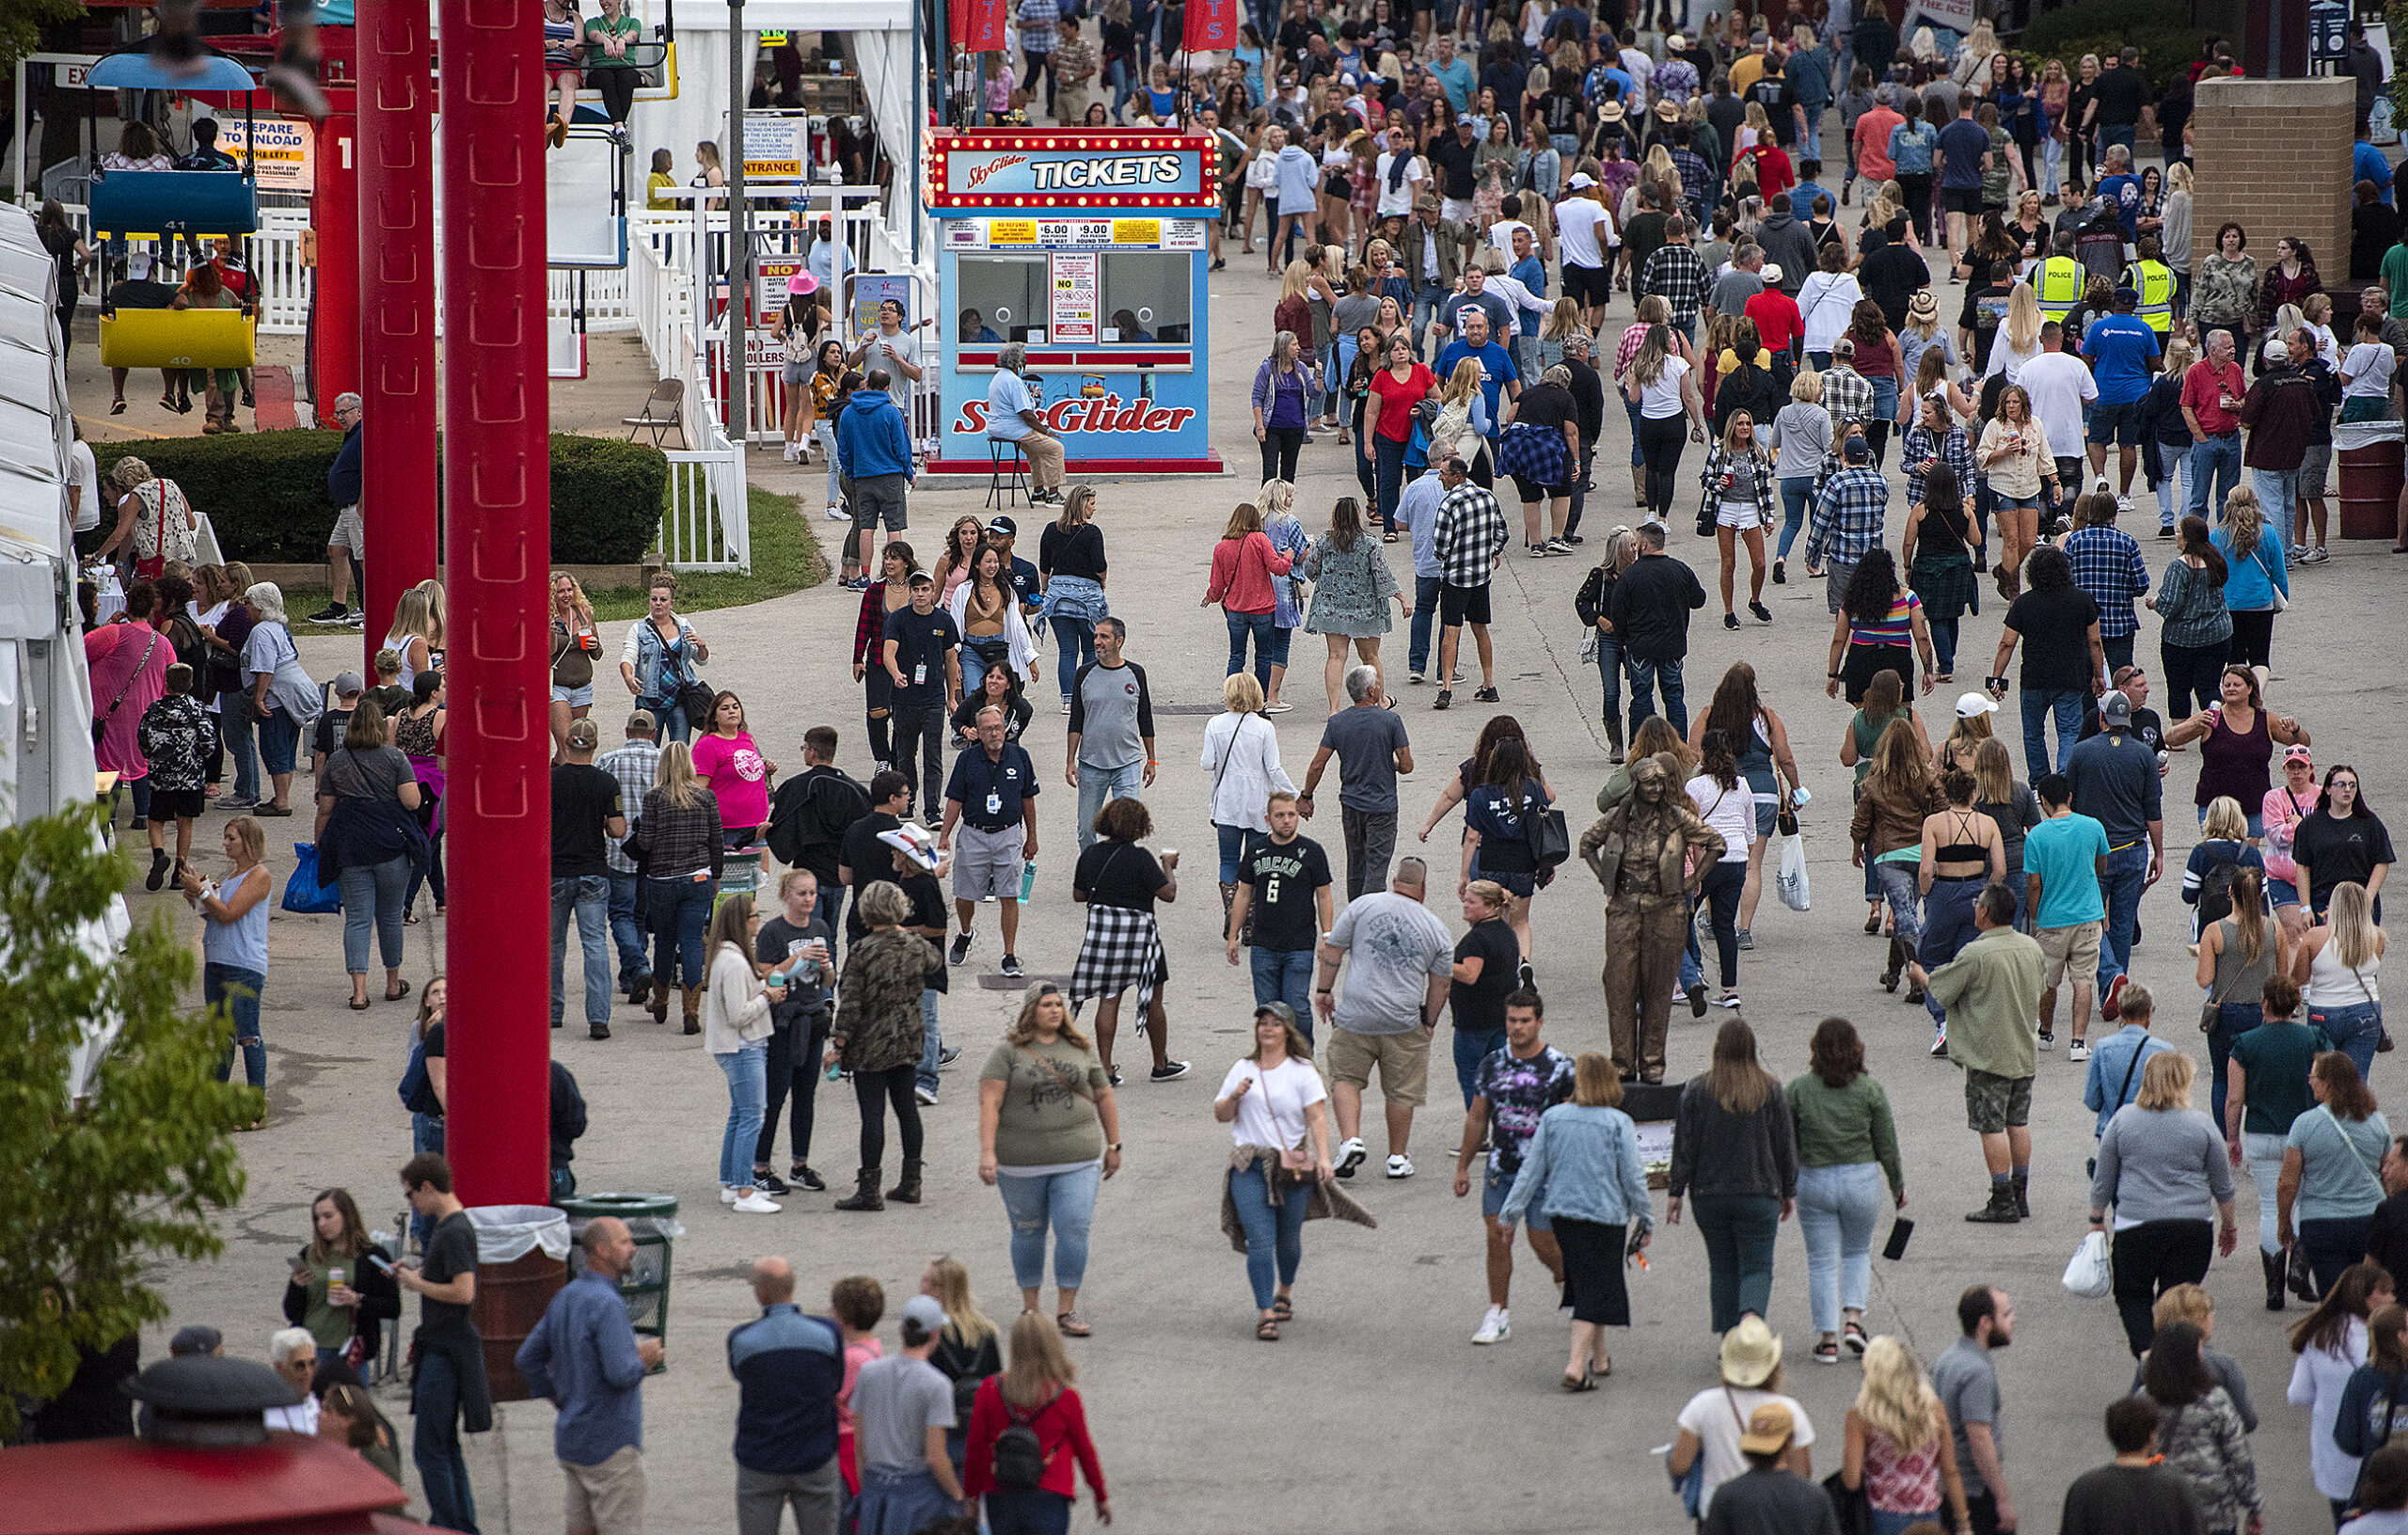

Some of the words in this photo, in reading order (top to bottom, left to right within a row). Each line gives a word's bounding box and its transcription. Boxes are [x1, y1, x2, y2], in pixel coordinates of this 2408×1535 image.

[68, 67, 88, 85] EX
[224, 132, 242, 143] TO
[252, 135, 303, 146] NLOAD
[235, 150, 247, 158] TO
[269, 150, 291, 159] LEFT
[338, 136, 352, 169] 1
[744, 163, 797, 172] NTRANCE
[967, 154, 1029, 189] SkyGlider
[1030, 154, 1181, 189] TICKETS
[165, 220, 185, 230] 41
[1040, 225, 1068, 234] $6.00
[1080, 225, 1107, 234] $9.00
[767, 265, 793, 275] NO
[2147, 274, 2169, 282] POLICE
[747, 340, 764, 351] NO
[170, 356, 192, 366] 40
[953, 392, 1196, 434] SGlider
[1252, 856, 1303, 878] BUCKS
[1266, 879, 1280, 903] 6
